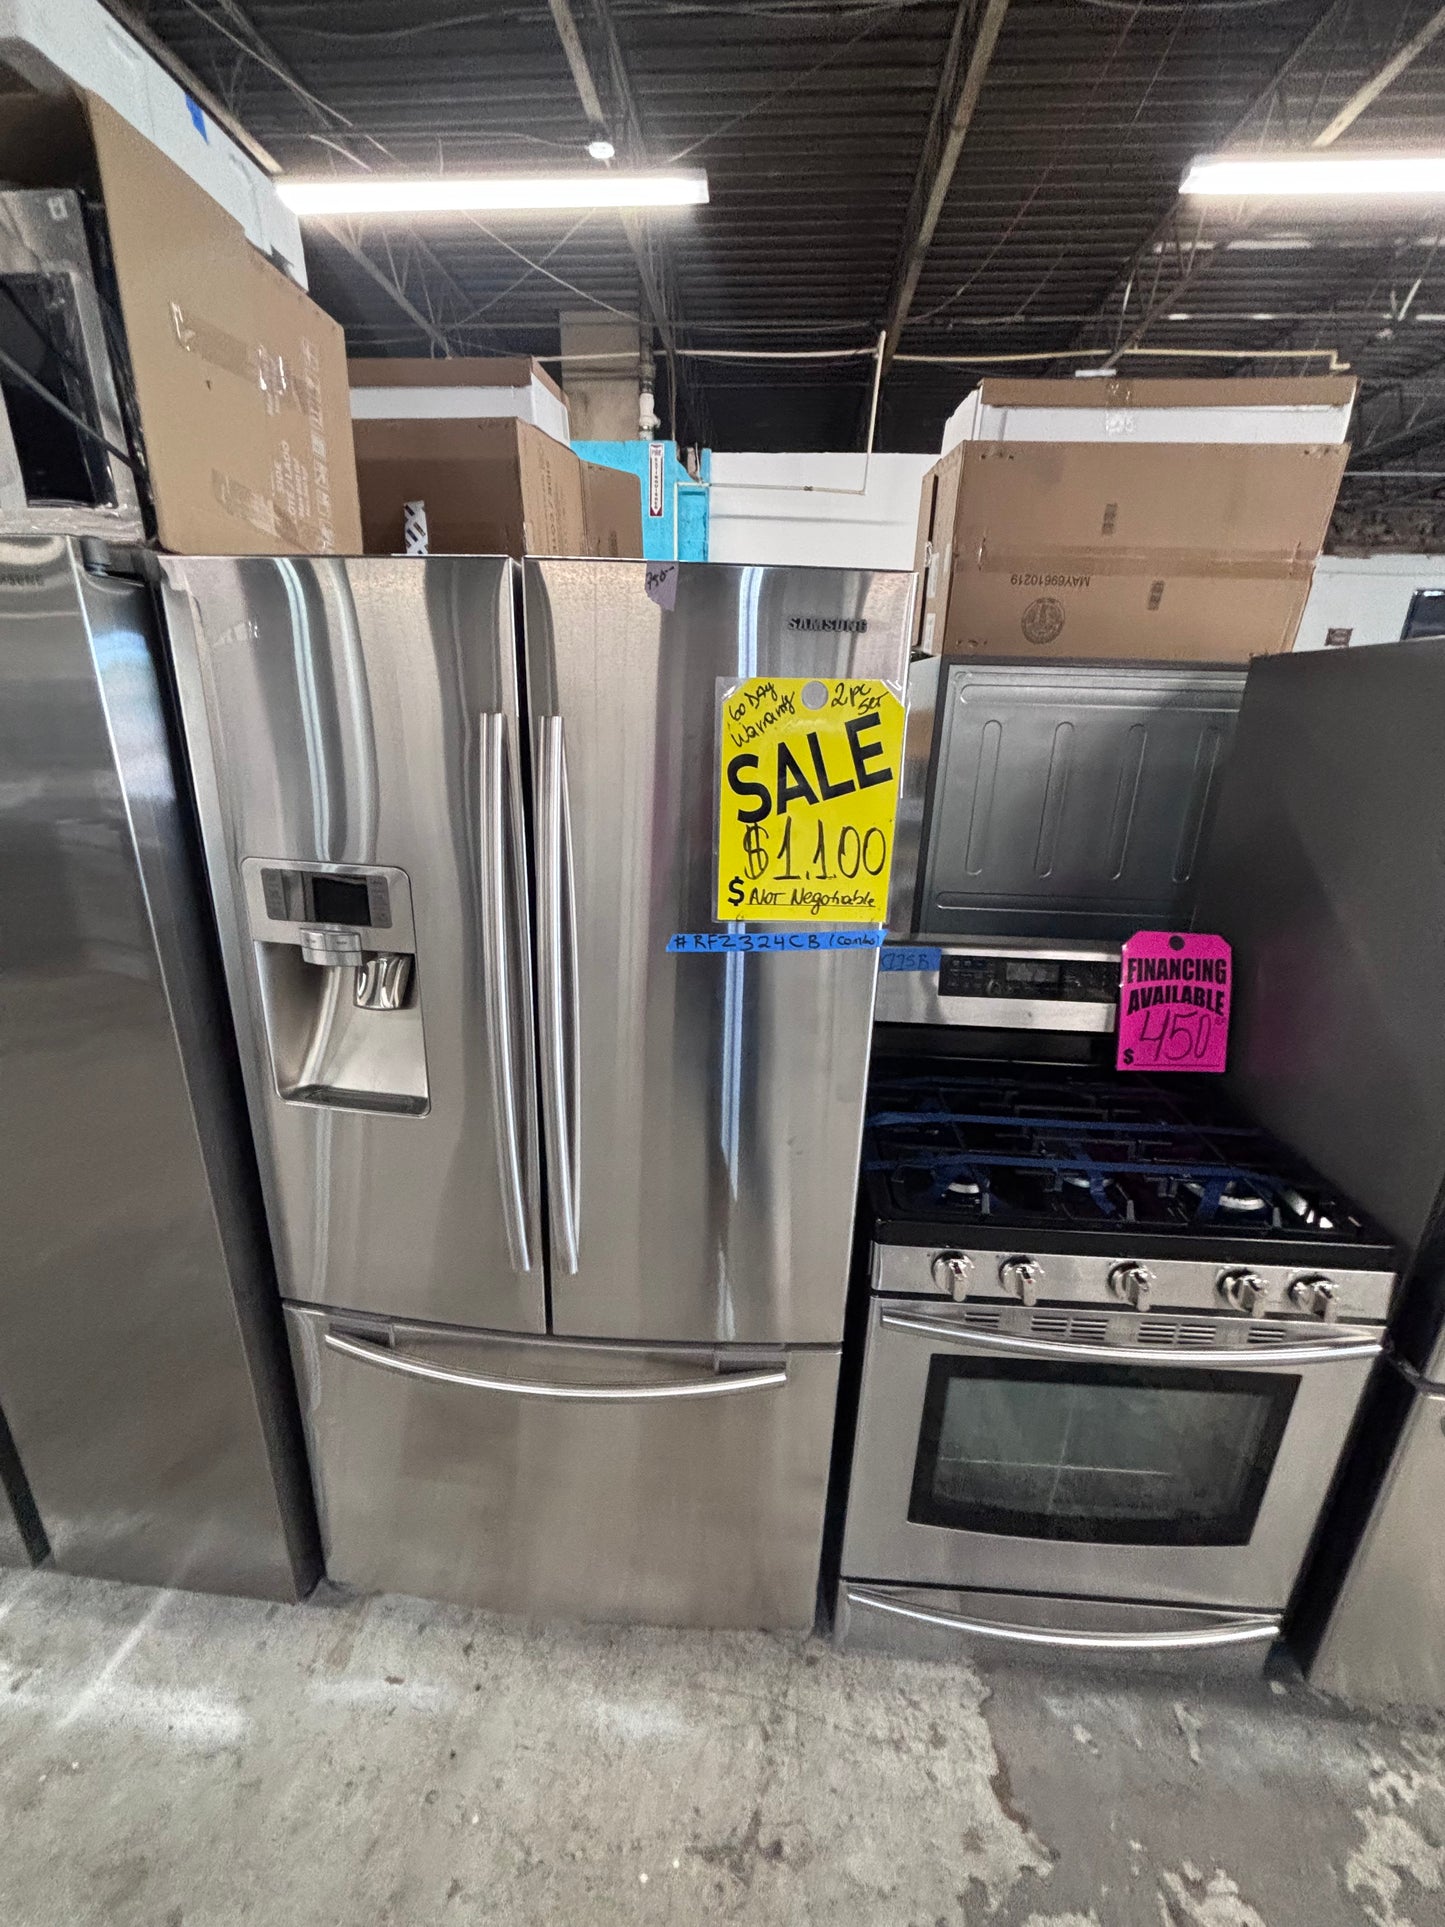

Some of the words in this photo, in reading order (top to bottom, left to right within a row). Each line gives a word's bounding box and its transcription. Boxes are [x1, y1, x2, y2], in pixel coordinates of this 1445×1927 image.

[1010, 573, 1091, 588] MAY69610219
[788, 617, 868, 634] SAMSUNG
[831, 682, 848, 708] 2
[727, 711, 894, 824] SALE
[727, 876, 745, 906] $
[1126, 957, 1227, 986] FINANCING
[1126, 984, 1226, 1017] AVAILABLE
[1123, 1047, 1135, 1066] $
